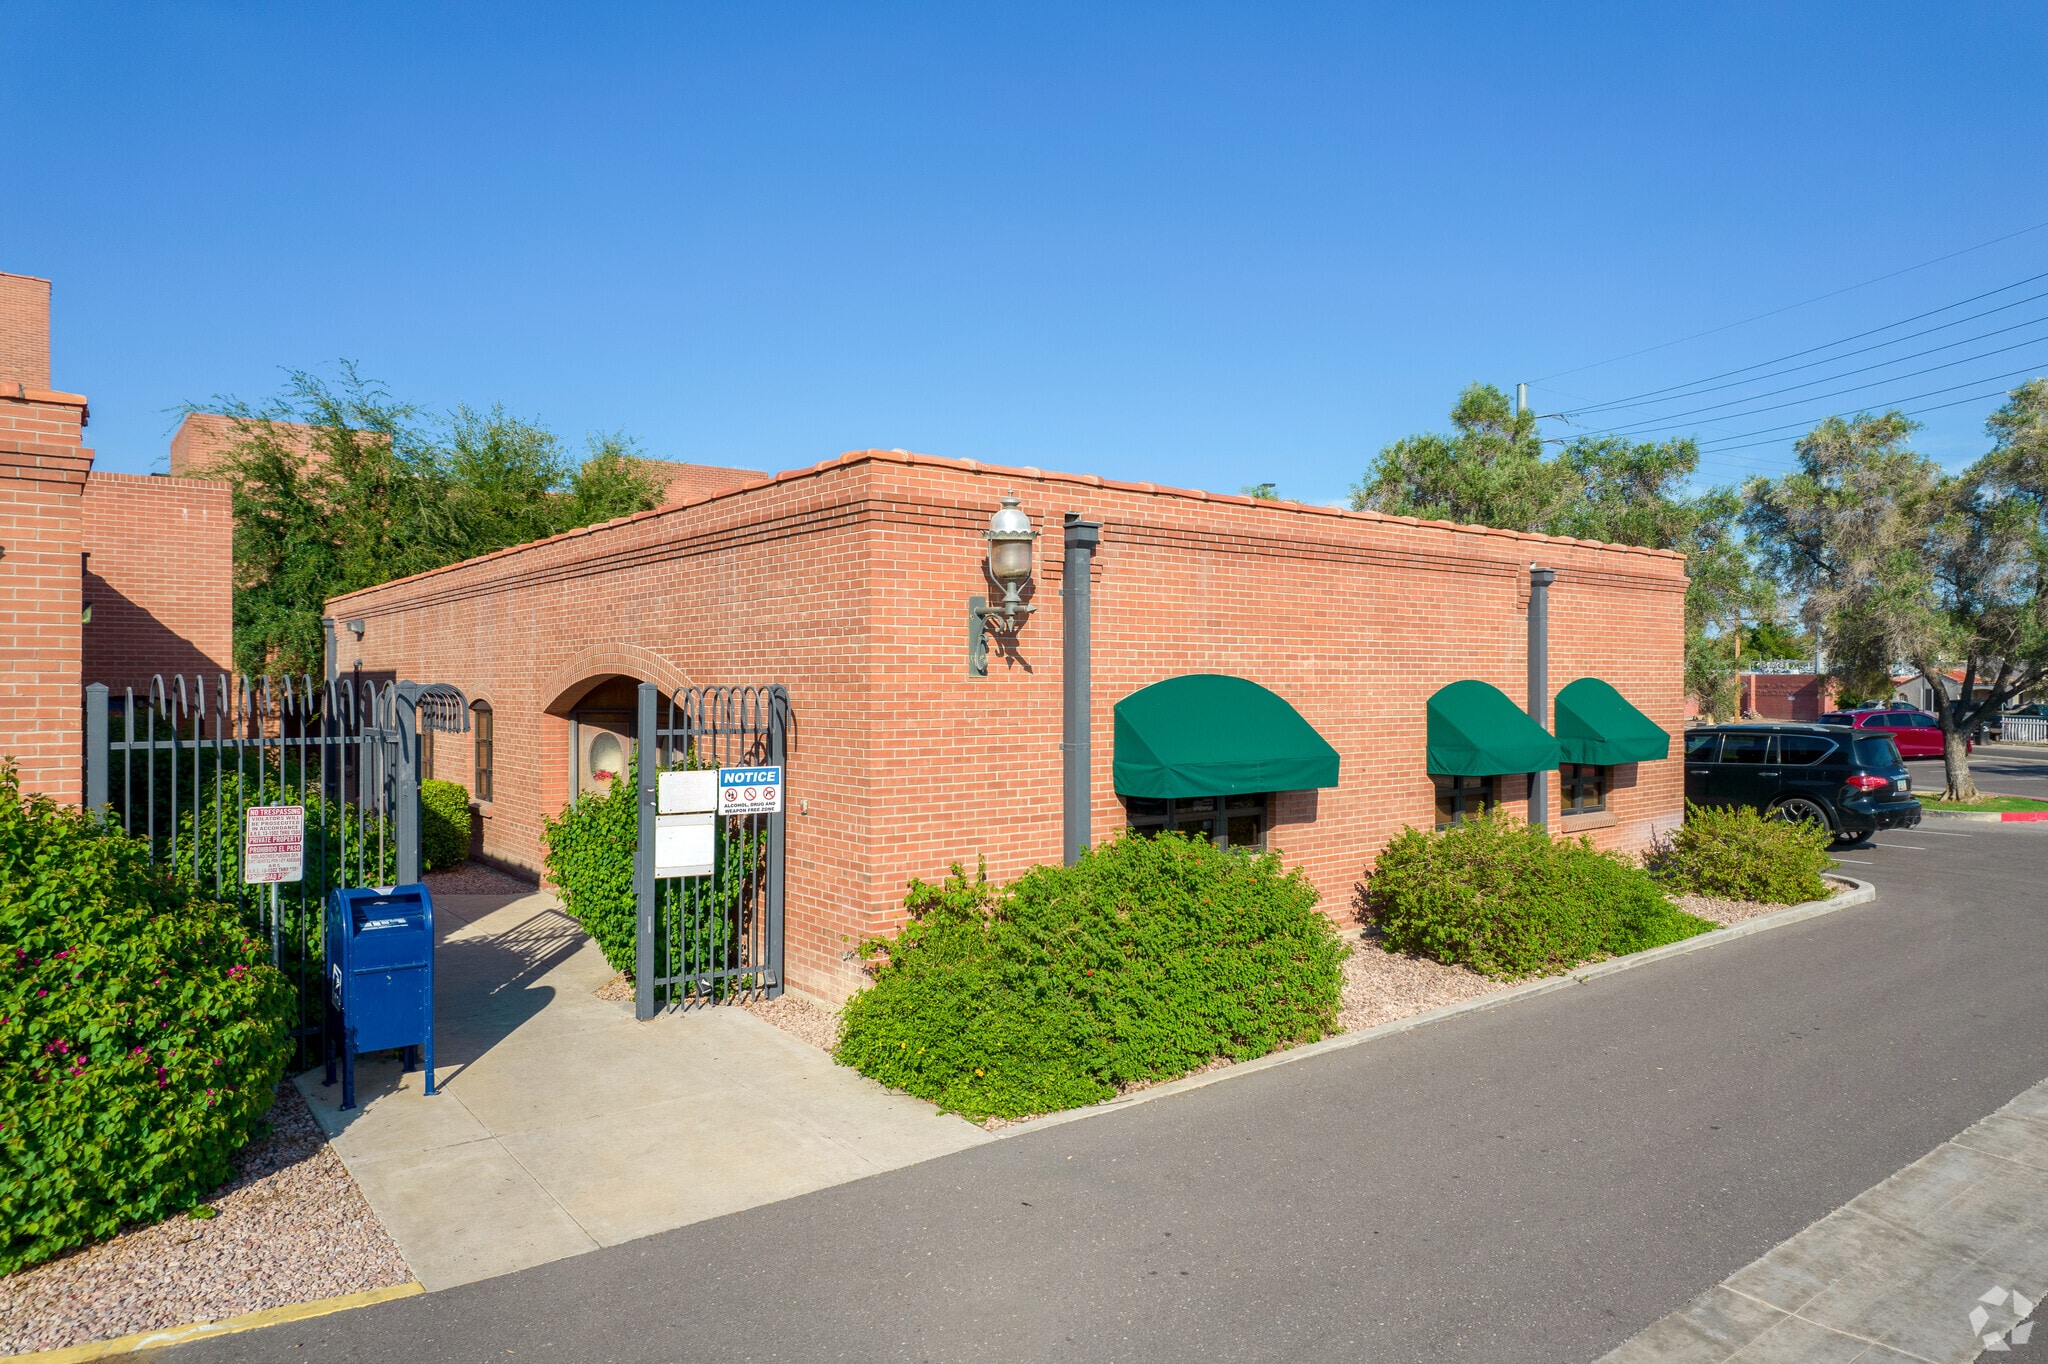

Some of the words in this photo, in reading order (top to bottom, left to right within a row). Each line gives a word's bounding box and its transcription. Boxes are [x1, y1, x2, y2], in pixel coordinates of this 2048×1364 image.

[724, 771, 776, 783] NOTICE
[260, 808, 301, 816] TRESPASSING
[286, 844, 301, 852] PASO
